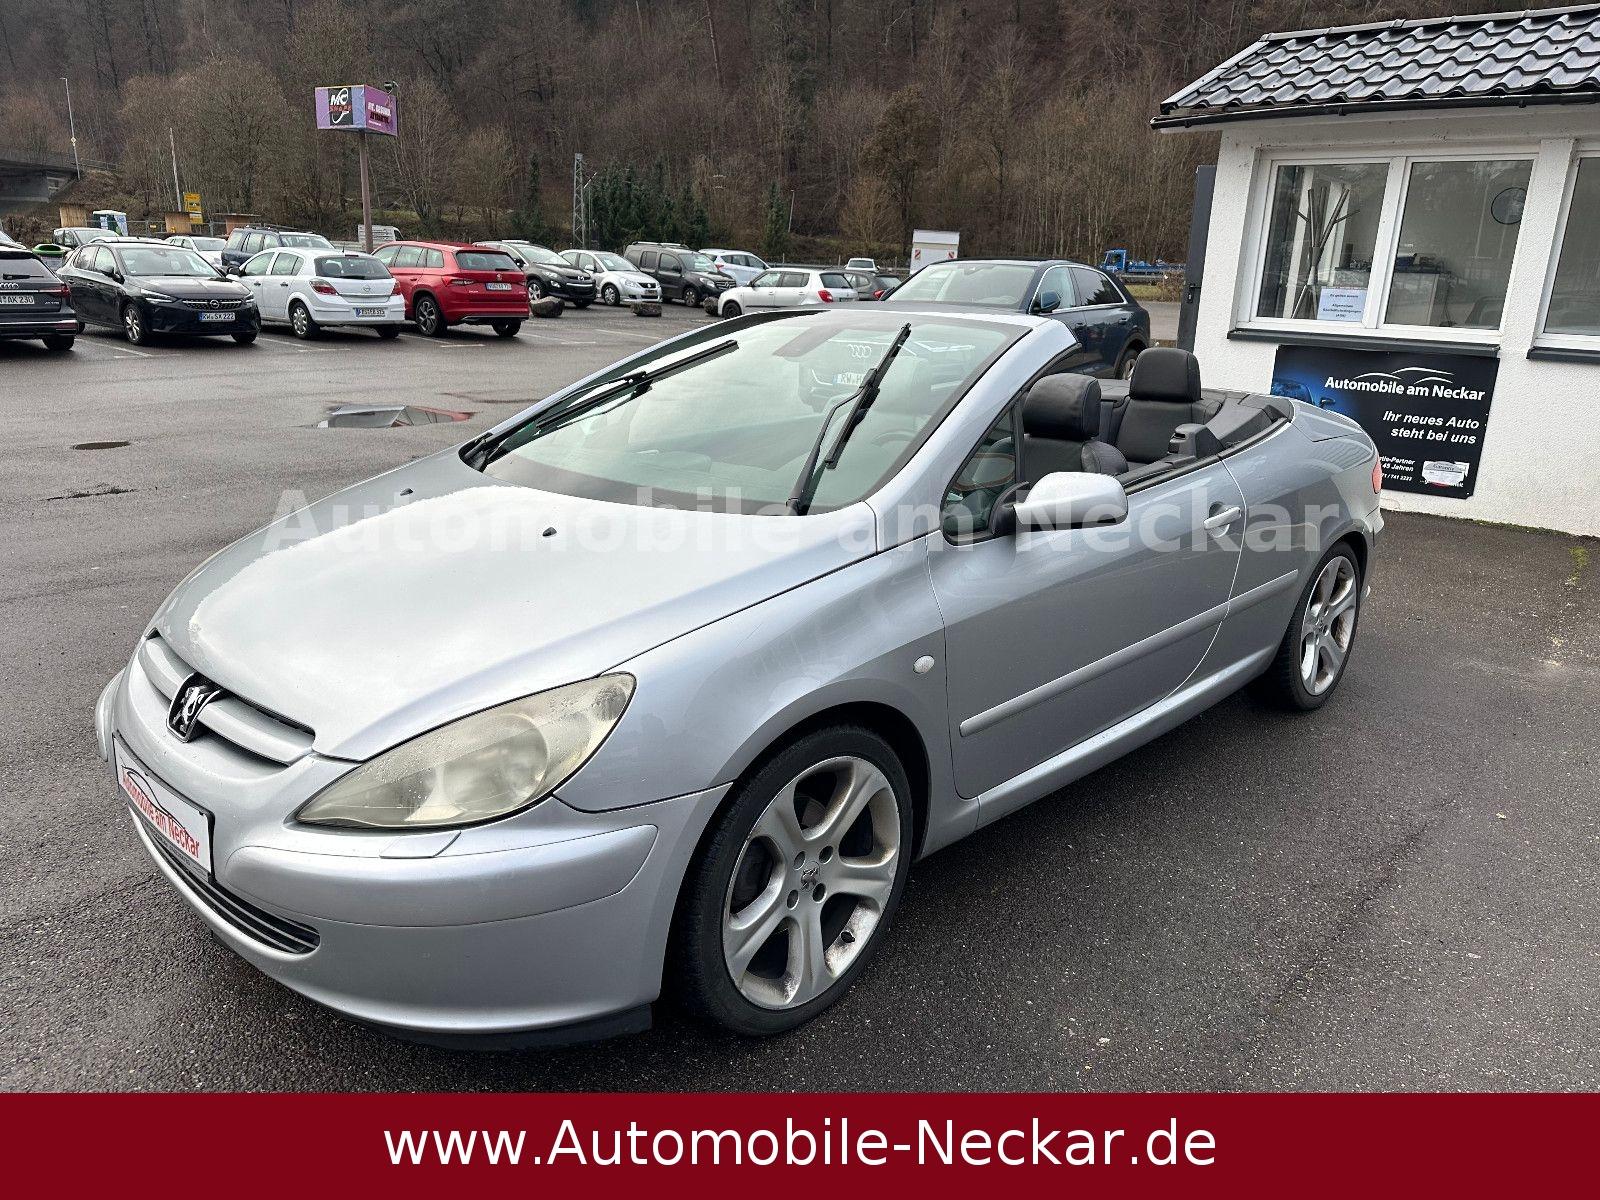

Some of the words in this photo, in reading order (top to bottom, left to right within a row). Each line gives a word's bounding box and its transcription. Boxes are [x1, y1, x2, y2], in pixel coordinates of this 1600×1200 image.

[1324, 376, 1405, 395] Automobile
[1406, 384, 1430, 397] am
[1431, 385, 1486, 401] Neckar
[1382, 410, 1401, 422] Ihr
[1403, 413, 1443, 426] neues
[1445, 416, 1480, 429] Auto
[1390, 428, 1425, 439] steht
[1426, 429, 1448, 442] bei
[1450, 433, 1477, 445] uns
[1391, 463, 1414, 472] Jahren
[168, 816, 200, 859] Neckar
